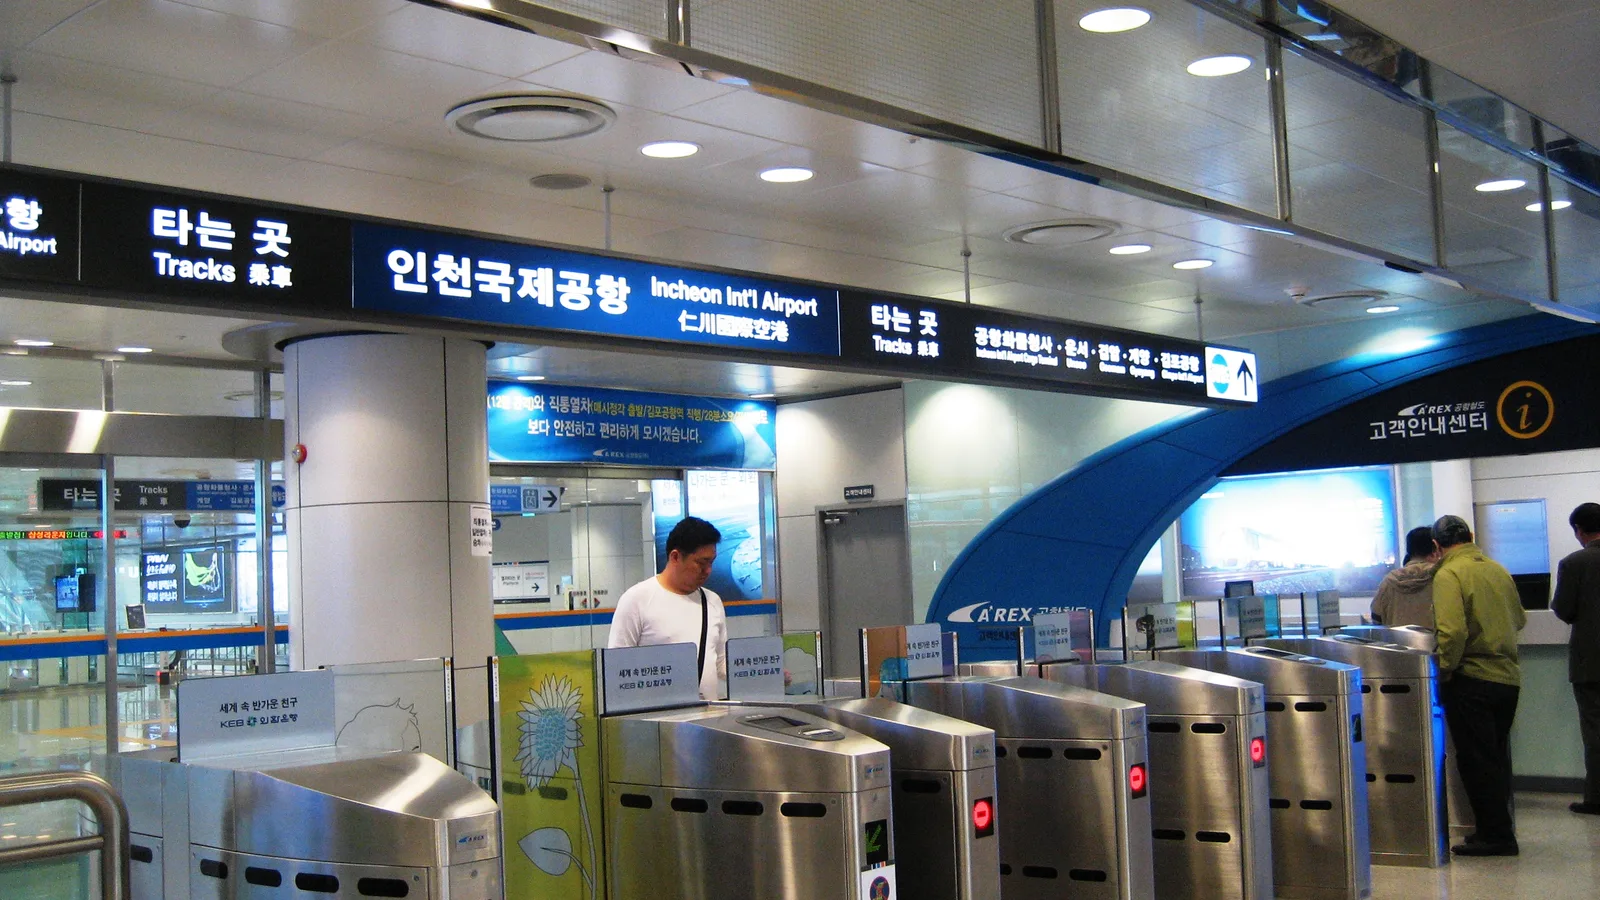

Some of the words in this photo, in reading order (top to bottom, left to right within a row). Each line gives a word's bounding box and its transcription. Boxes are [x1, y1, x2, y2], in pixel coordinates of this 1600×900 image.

[0, 197, 43, 231] 항
[153, 208, 236, 251] 타는
[252, 219, 292, 258] 곳
[153, 252, 236, 283] Tracks
[386, 248, 631, 316] 인천국제공항
[650, 275, 722, 305] Incheon
[762, 289, 818, 318] Airport
[870, 304, 912, 333] 타는
[918, 309, 938, 337] 곳
[872, 334, 913, 355] Tracks
[527, 419, 550, 436] 보다
[553, 420, 596, 437] 안전하고
[600, 422, 640, 440] 편리하게
[1369, 412, 1488, 440] 고객안내센터
[63, 487, 98, 503] 타는
[139, 485, 168, 495] Tracks
[619, 669, 631, 678] 세계
[633, 668, 639, 677] 속
[641, 665, 659, 677] 반가운
[660, 665, 672, 674] 친구
[220, 702, 238, 713] 세계
[241, 701, 250, 711] 속
[252, 698, 279, 711] 반가운
[281, 697, 298, 709] 친구
[220, 719, 245, 728] KEB
[260, 713, 298, 725] 외환은행
